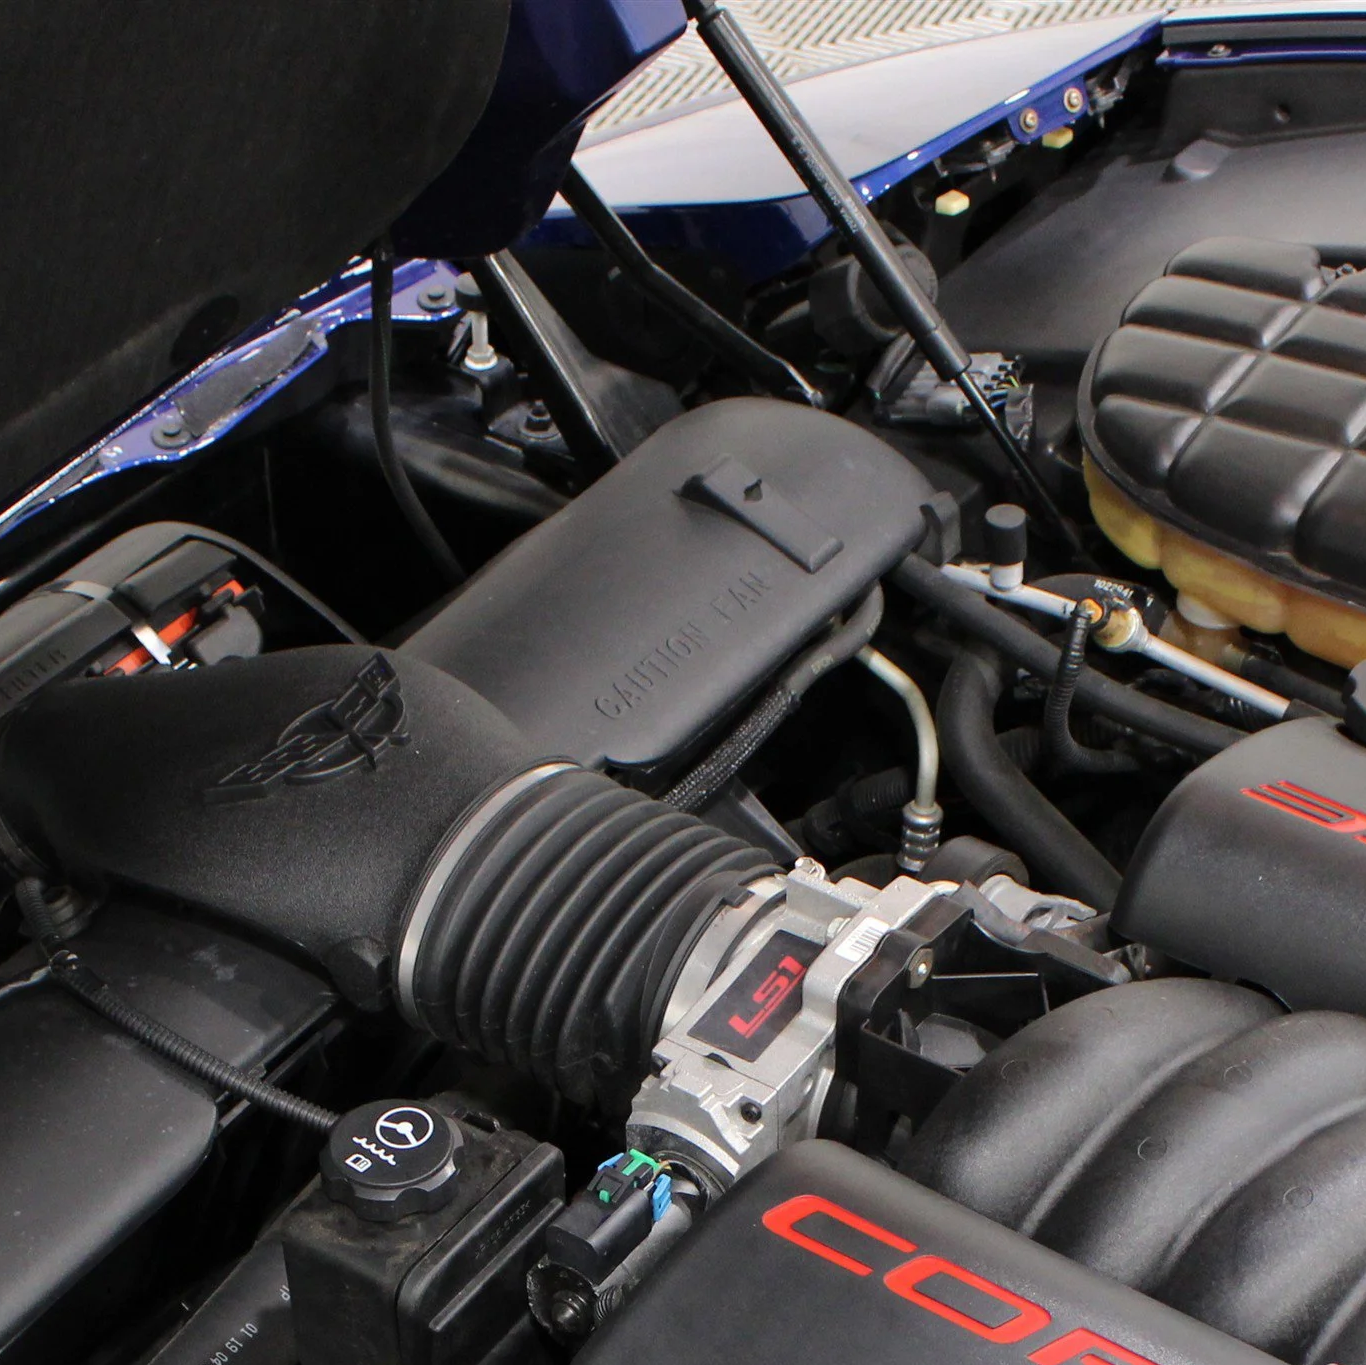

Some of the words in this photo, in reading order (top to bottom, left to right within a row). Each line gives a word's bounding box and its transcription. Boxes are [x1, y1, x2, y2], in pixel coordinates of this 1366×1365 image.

[586, 617, 715, 728] CAUTION
[708, 566, 774, 626] FAN
[727, 957, 807, 1039] LS1
[225, 1336, 244, 1354] 19
[240, 1322, 259, 1339] 01
